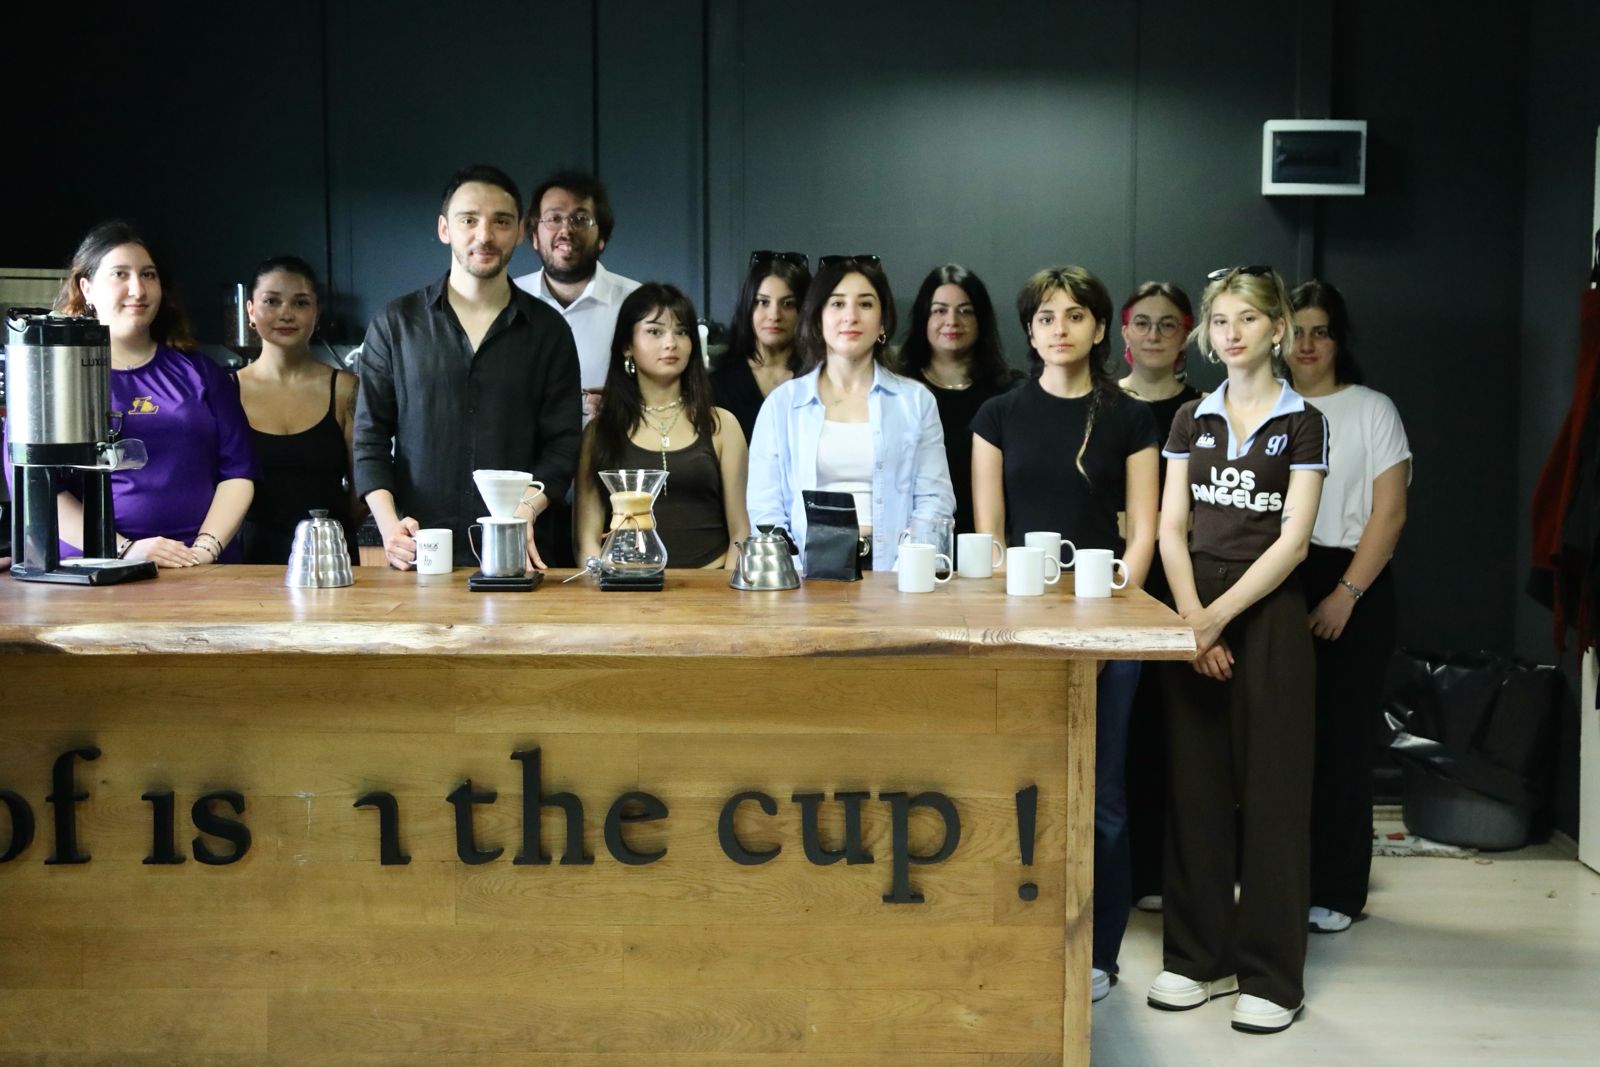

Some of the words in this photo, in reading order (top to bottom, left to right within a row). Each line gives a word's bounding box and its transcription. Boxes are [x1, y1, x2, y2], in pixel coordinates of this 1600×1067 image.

[1211, 466, 1255, 491] LOS
[1191, 483, 1282, 512] ANGELES
[446, 747, 669, 866] the
